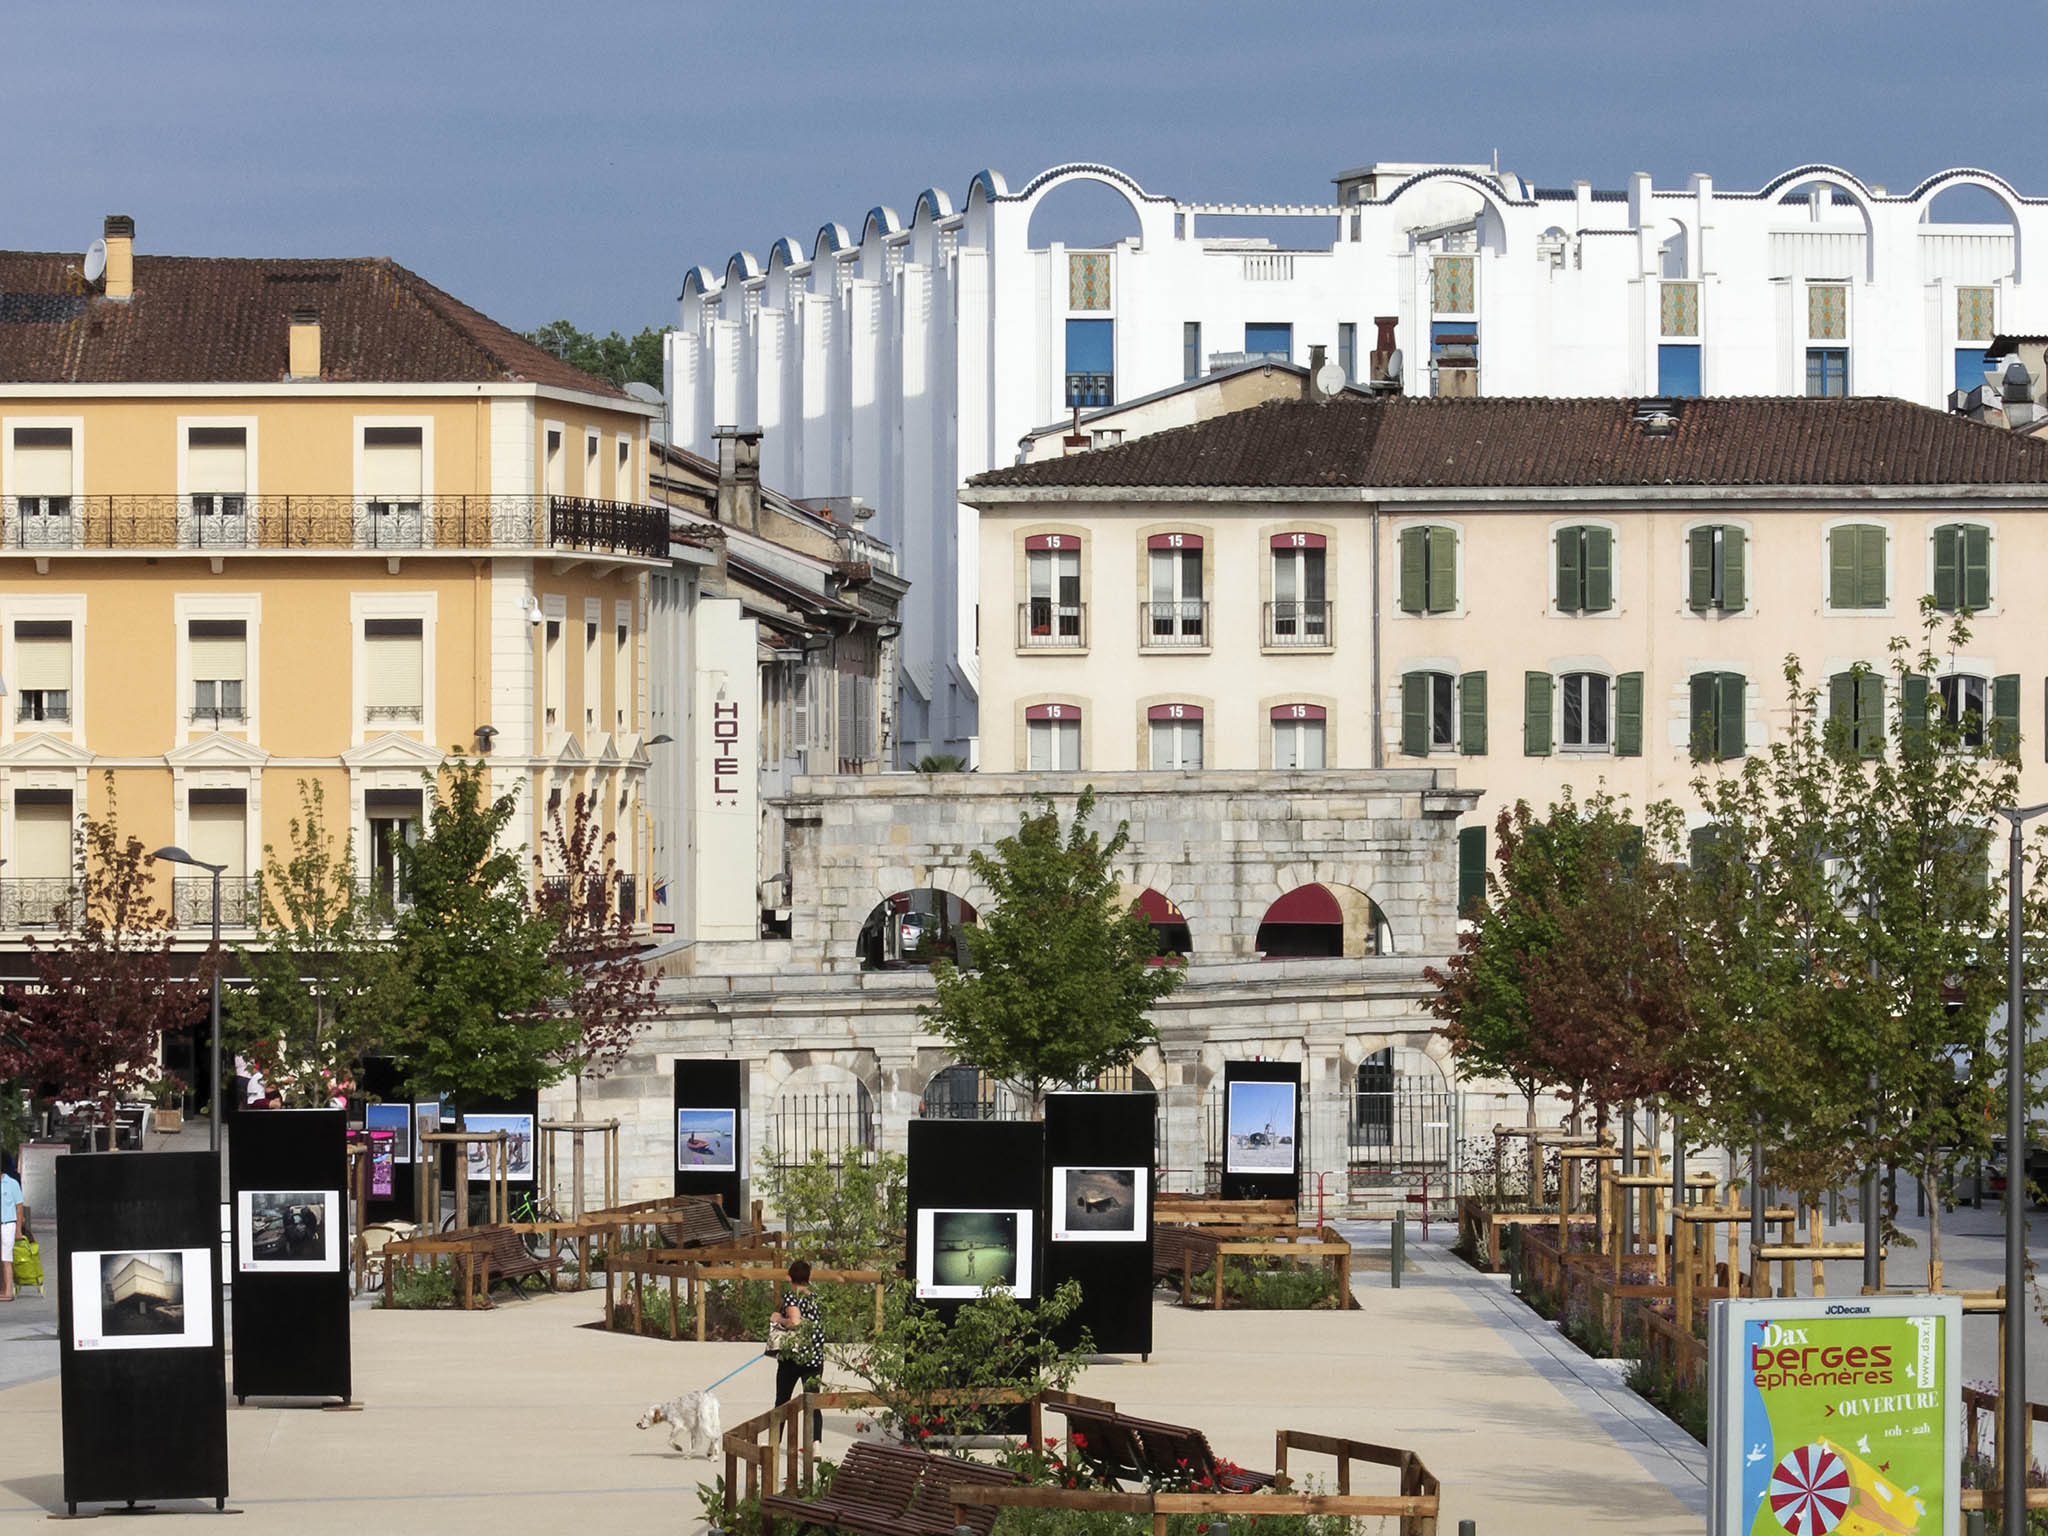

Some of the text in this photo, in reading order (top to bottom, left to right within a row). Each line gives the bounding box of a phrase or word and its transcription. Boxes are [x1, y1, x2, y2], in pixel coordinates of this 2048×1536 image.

[1046, 536, 1060, 548] 15
[1168, 535, 1182, 547] 15
[1291, 535, 1305, 547] 15
[1046, 705, 1060, 718] 15
[1169, 705, 1183, 718] 15
[1291, 705, 1305, 718] 15
[714, 702, 738, 793] HOTEL
[1825, 1305, 1871, 1315] JCDecaux
[1763, 1323, 1808, 1348] Dax
[1752, 1344, 1892, 1370] berges
[1753, 1368, 1893, 1391] éphémères
[1839, 1391, 1939, 1417] OUVERTURE
[1884, 1424, 1902, 1437] 10h
[1912, 1422, 1931, 1435] 22h
